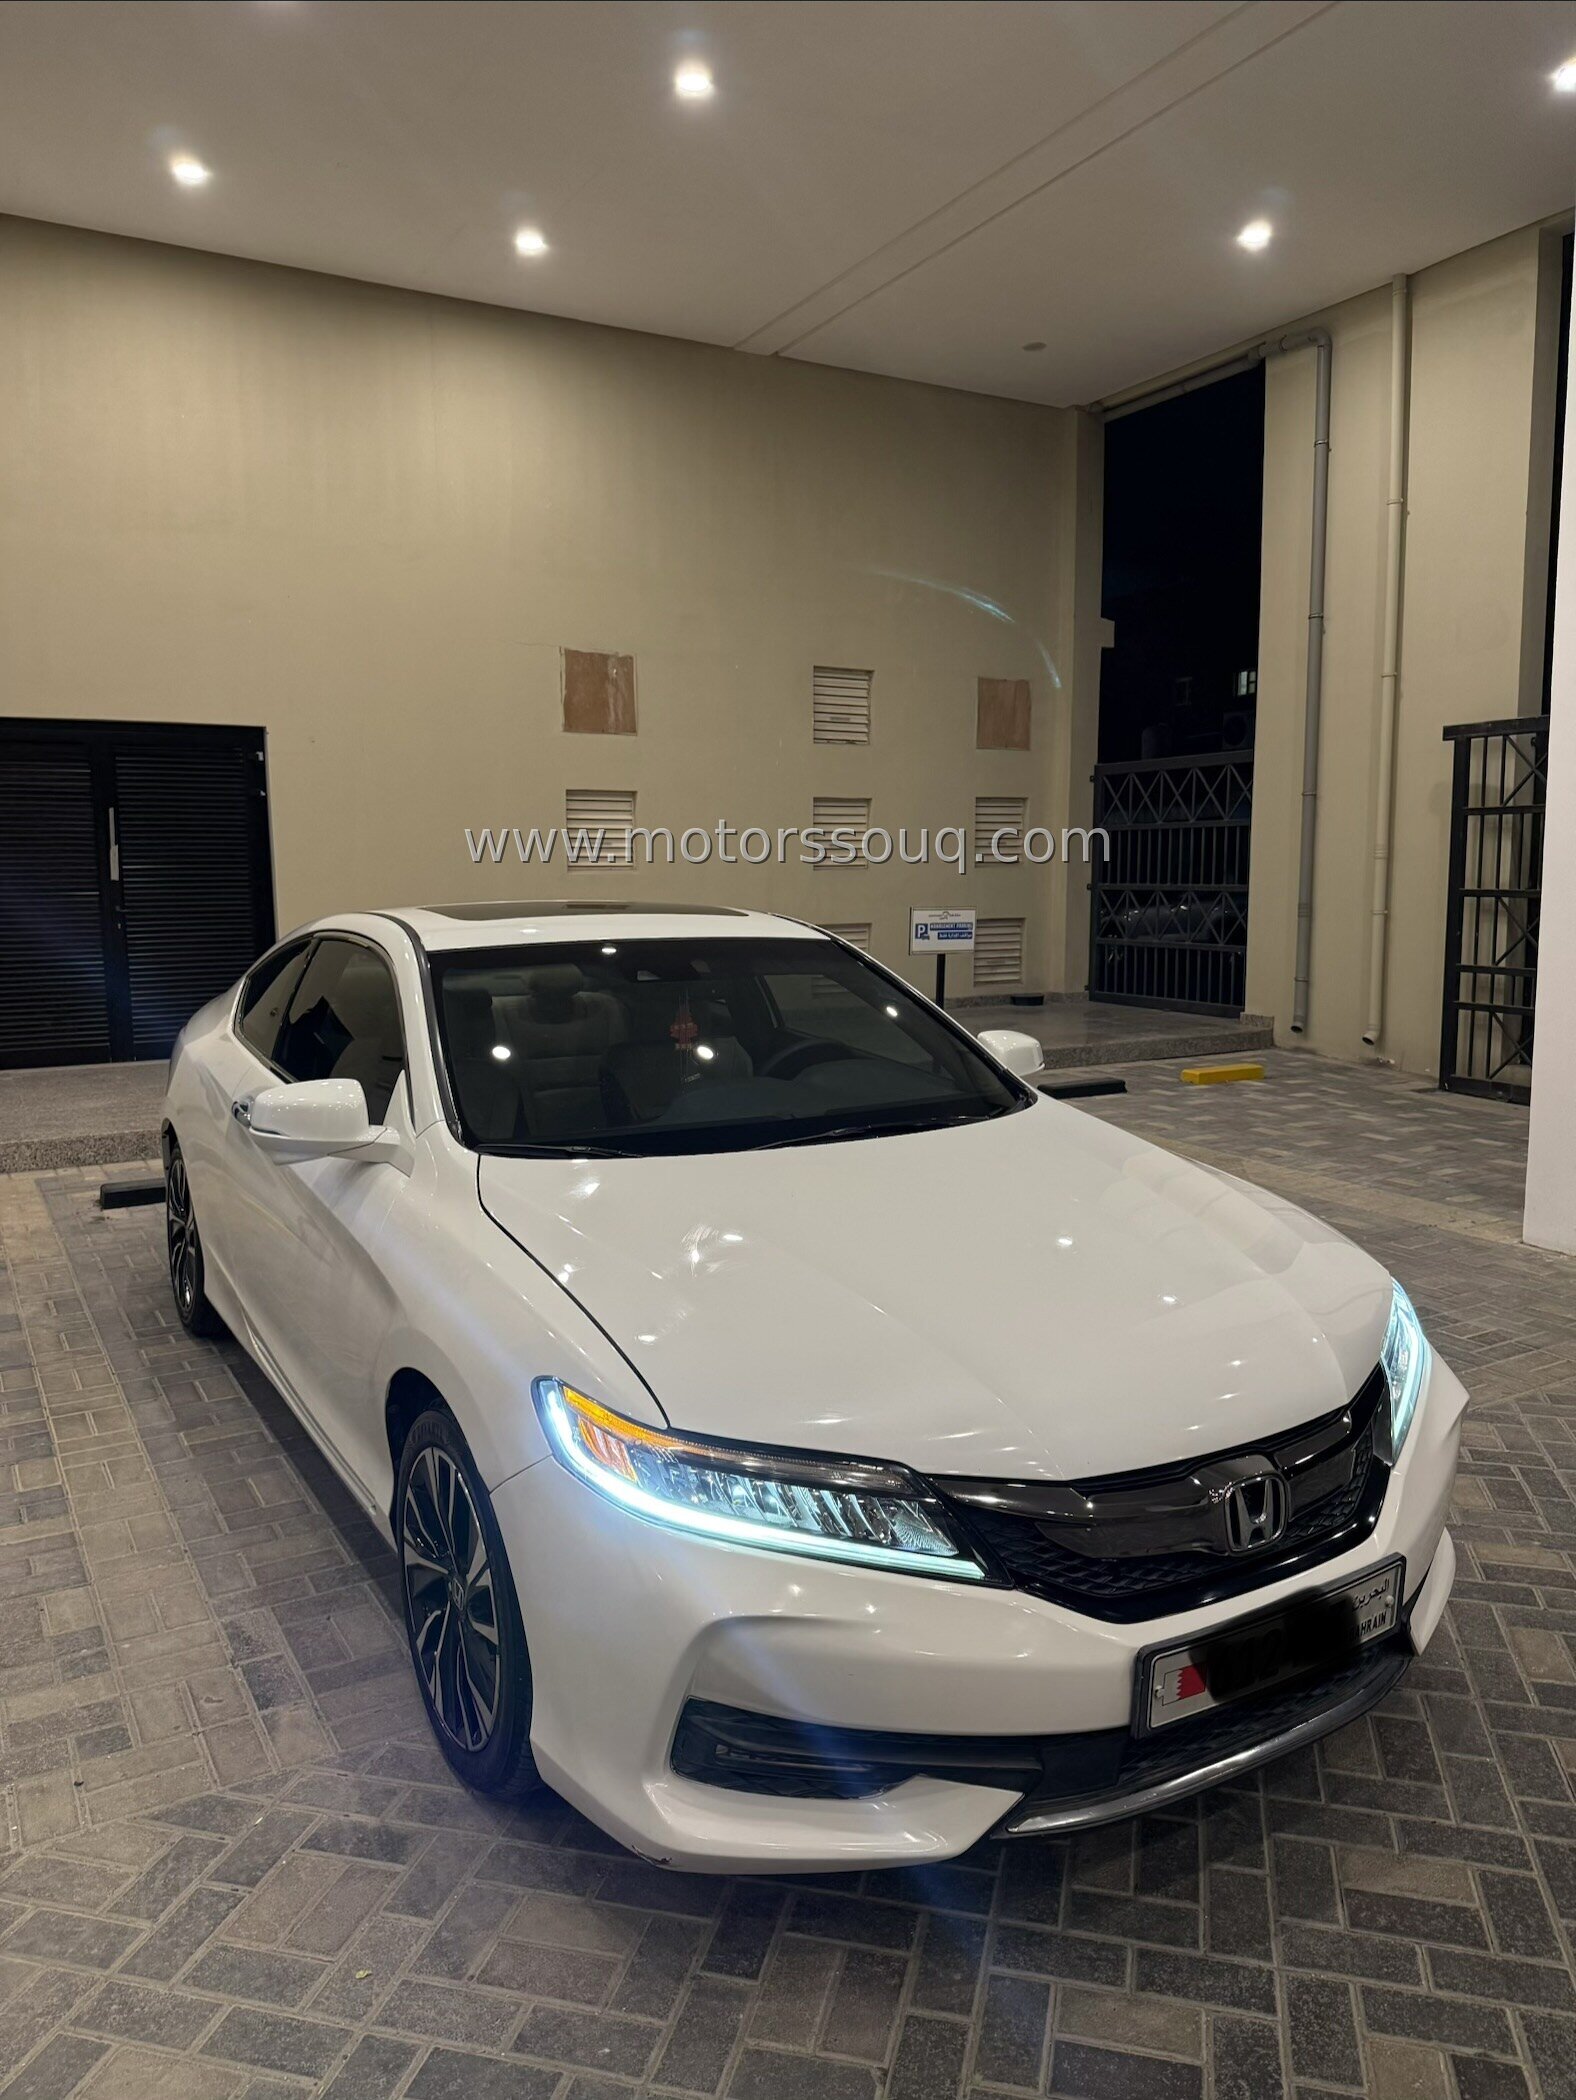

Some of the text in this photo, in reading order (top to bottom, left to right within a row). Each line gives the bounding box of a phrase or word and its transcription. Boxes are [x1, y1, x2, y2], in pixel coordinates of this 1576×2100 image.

[917, 925, 926, 938] P
[1353, 1578, 1390, 1611] البحرين
[1350, 1611, 1388, 1641] AHRAIN
